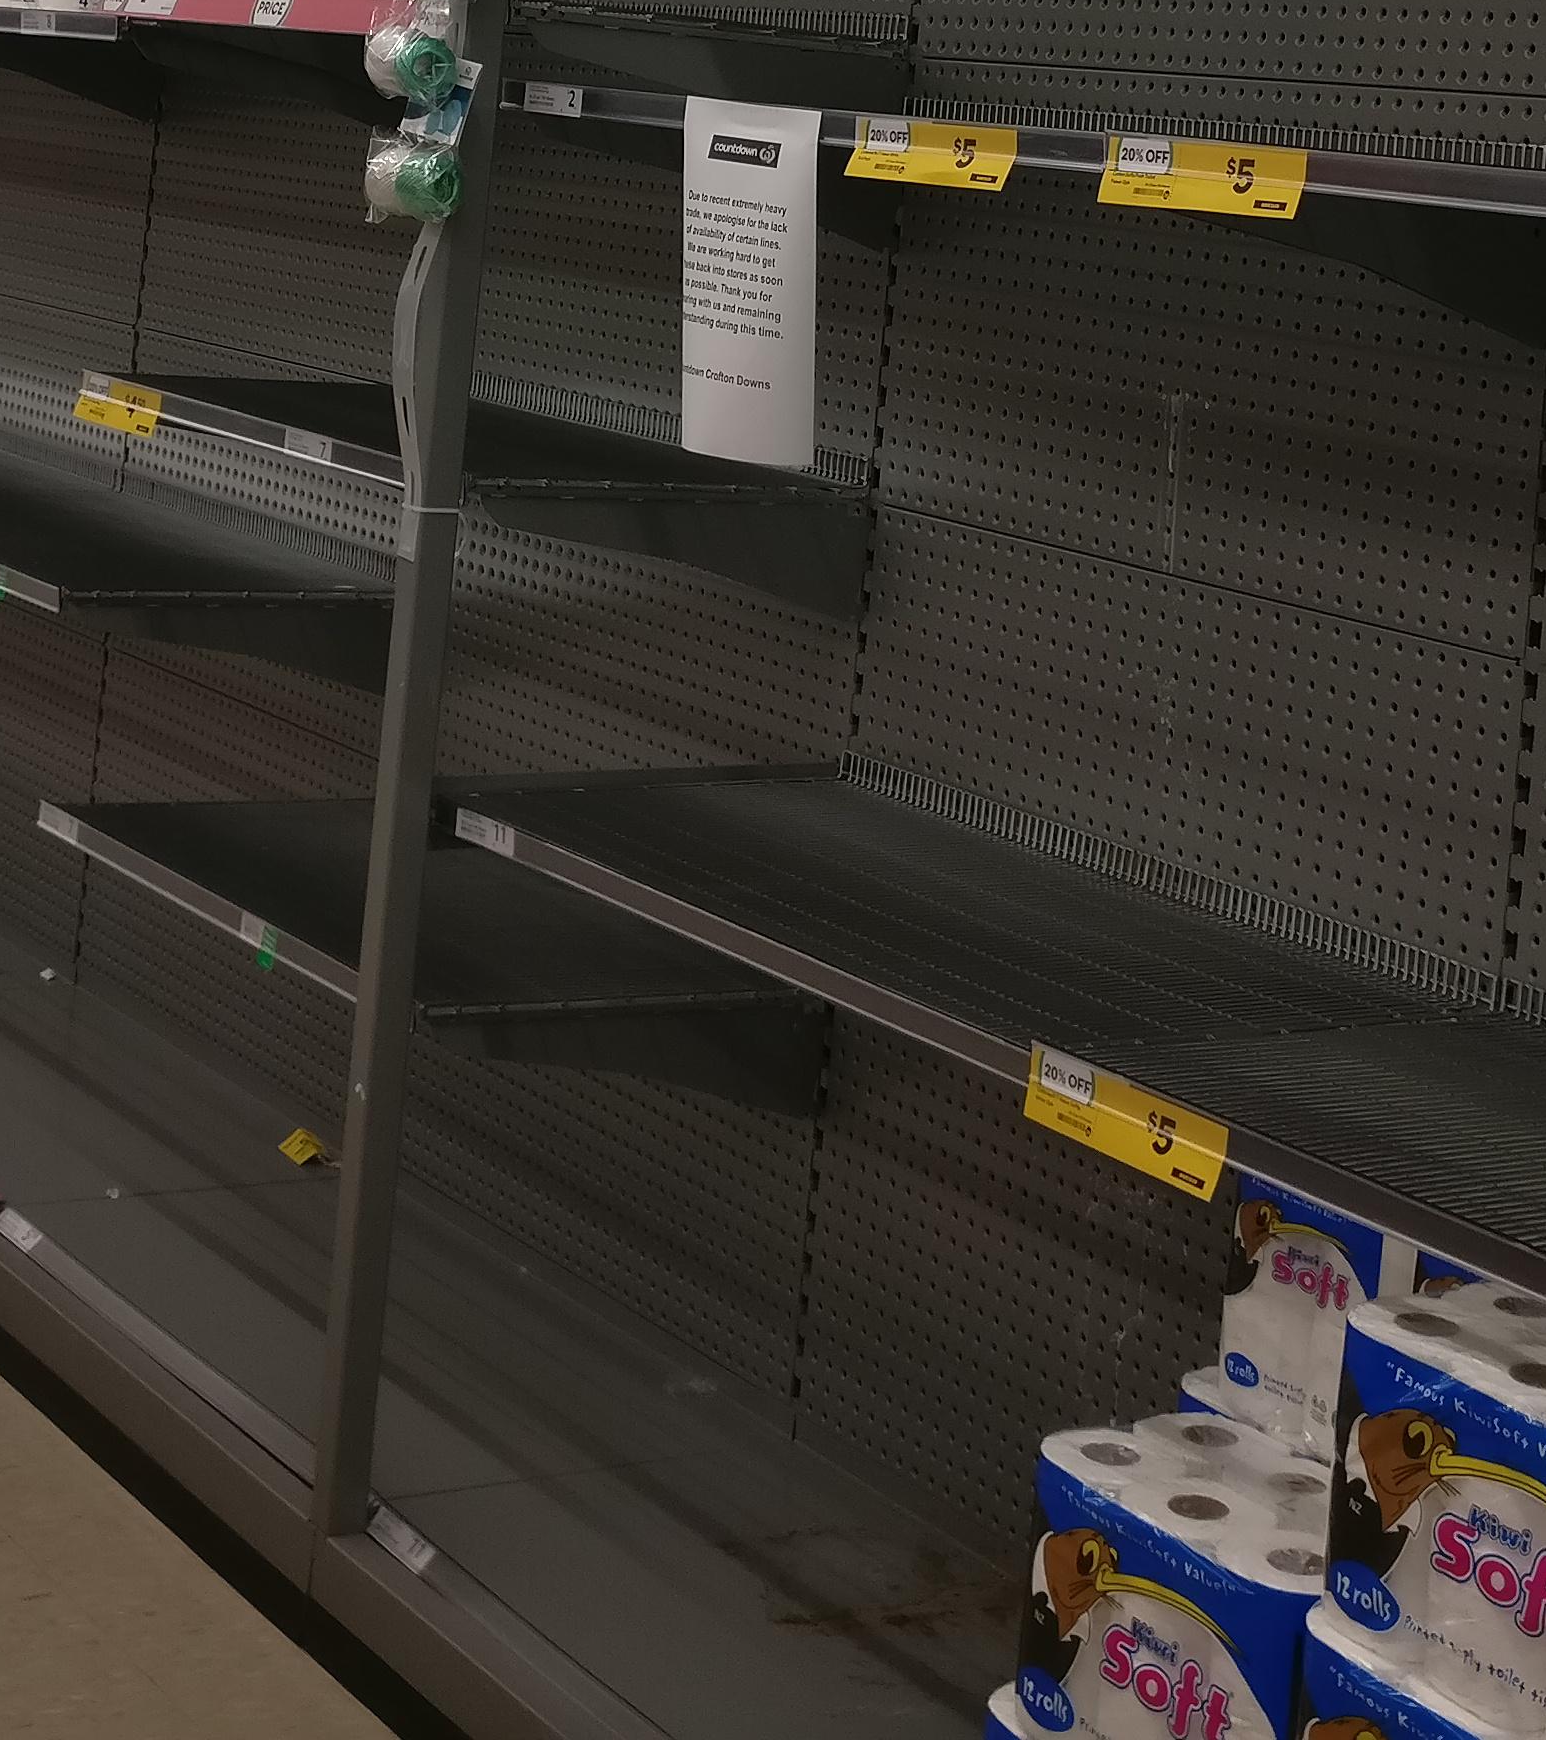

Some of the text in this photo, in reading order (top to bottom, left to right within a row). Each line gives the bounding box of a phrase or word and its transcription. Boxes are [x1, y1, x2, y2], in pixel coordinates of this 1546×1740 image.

[257, 1, 287, 16] PRICE
[714, 142, 758, 157] countdown
[870, 128, 908, 144] 20% OFF
[953, 136, 977, 169] $5
[1121, 147, 1170, 164] 20% OFF
[1226, 156, 1256, 195] $5
[688, 189, 787, 217] Due to recent extremely heavy
[703, 211, 788, 233] we apologise for the lack
[692, 226, 782, 251] availability of certain lines.
[696, 245, 776, 268] are working hard to get
[696, 261, 783, 287] back into stores as soon
[690, 279, 773, 302] possible. Thank you for
[698, 297, 782, 324] with us and remaining
[715, 318, 784, 340] during this time.
[705, 368, 771, 390] Crofton Downs
[1043, 1063, 1092, 1095] 20% OFF
[1147, 1110, 1177, 1155] $5
[1272, 1249, 1350, 1310] Soft
[1453, 1397, 1529, 1449] KiwiSoft
[1468, 1503, 1534, 1556] Kiwi
[1336, 1571, 1392, 1622] 12 rolls
[1131, 1617, 1181, 1666] Kiwi
[1403, 1615, 1445, 1644] Printed
[1487, 1662, 1526, 1695] toilet
[1099, 1623, 1231, 1740] Soft
[1022, 1676, 1068, 1723] 12 rolls
